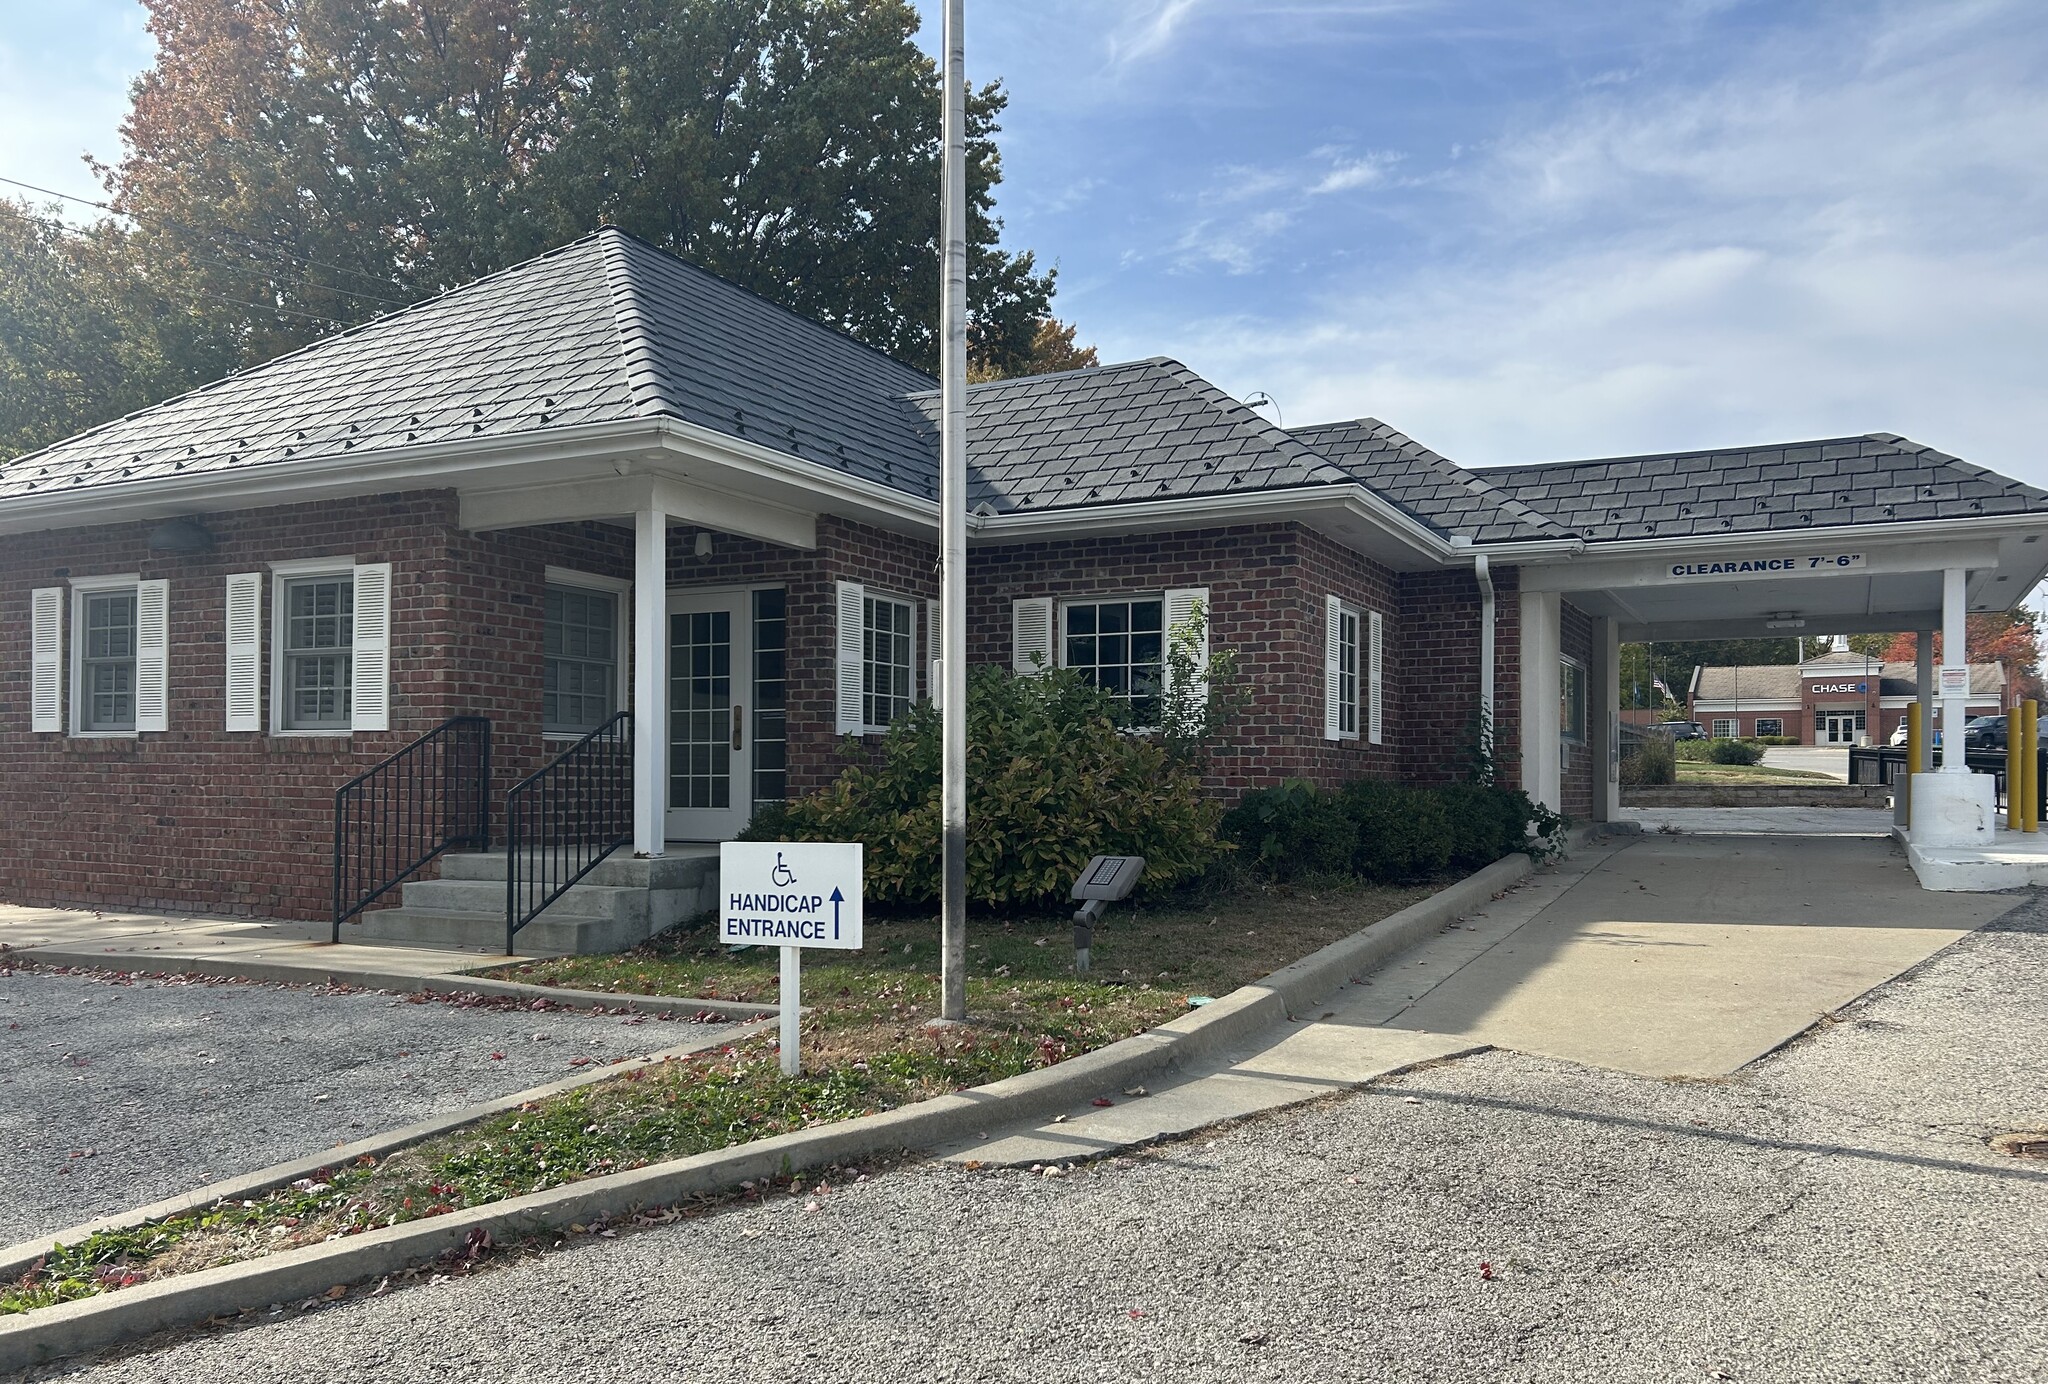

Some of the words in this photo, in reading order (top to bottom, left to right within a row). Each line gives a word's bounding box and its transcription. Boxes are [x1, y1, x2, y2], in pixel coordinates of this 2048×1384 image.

[1672, 559, 1795, 576] CLEARANCE
[1811, 683, 1856, 693] CHASE
[730, 893, 822, 913] HANDICAP
[727, 918, 825, 939] ENTRANCE
